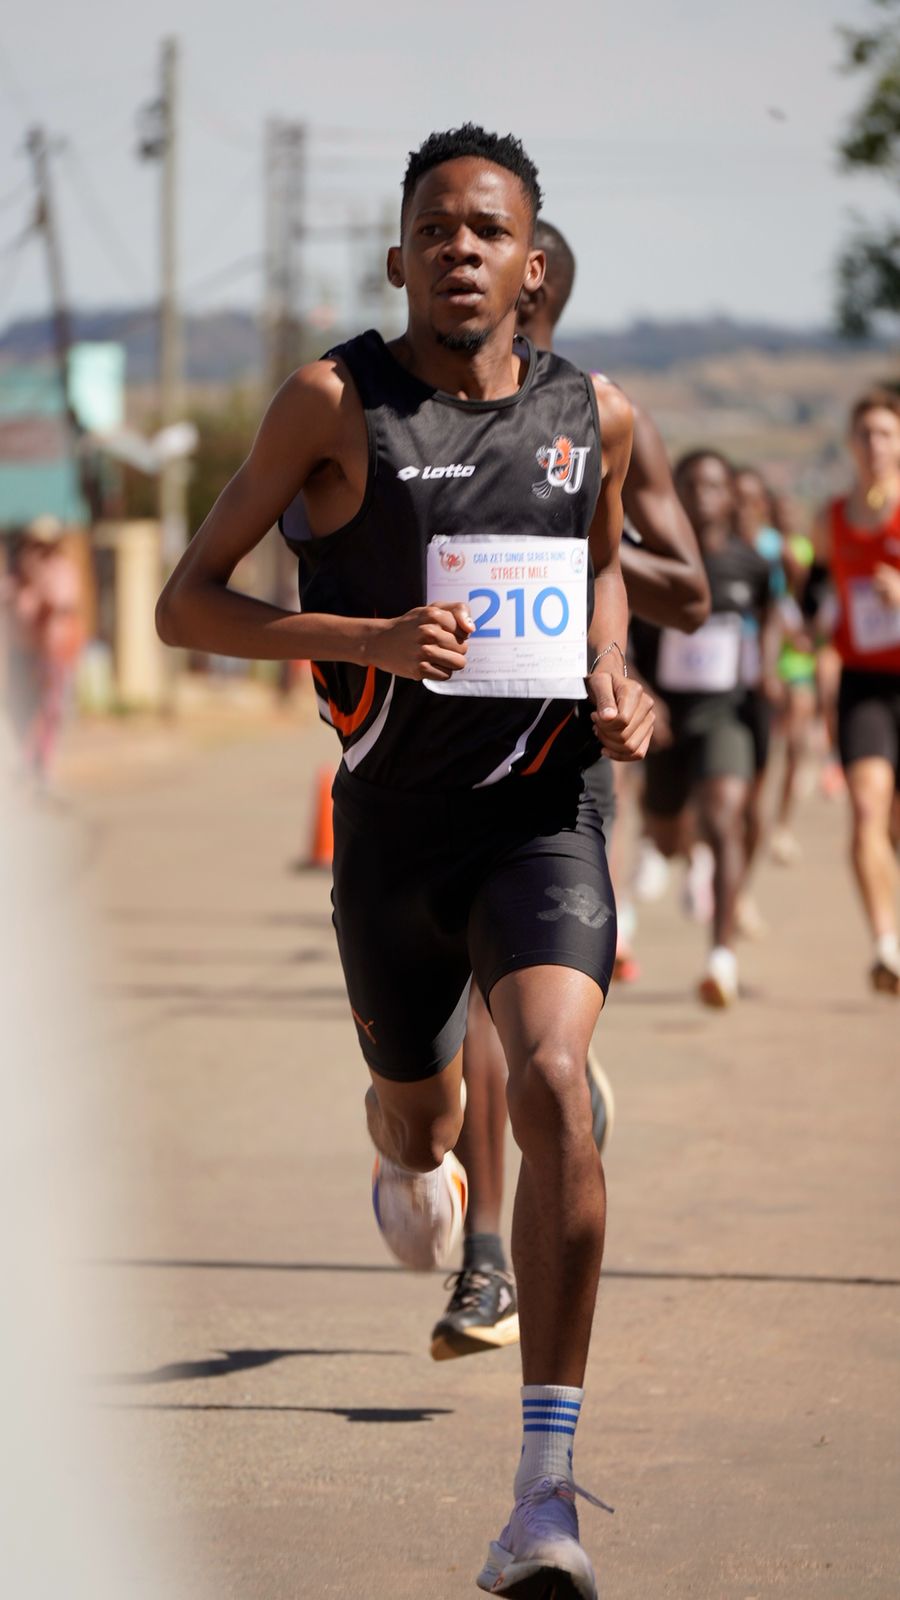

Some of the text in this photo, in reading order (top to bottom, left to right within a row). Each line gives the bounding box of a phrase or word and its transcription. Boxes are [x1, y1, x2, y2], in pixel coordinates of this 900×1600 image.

[547, 446, 591, 495] UJ
[490, 565, 549, 580] STREET MILE
[468, 586, 570, 638] 210
